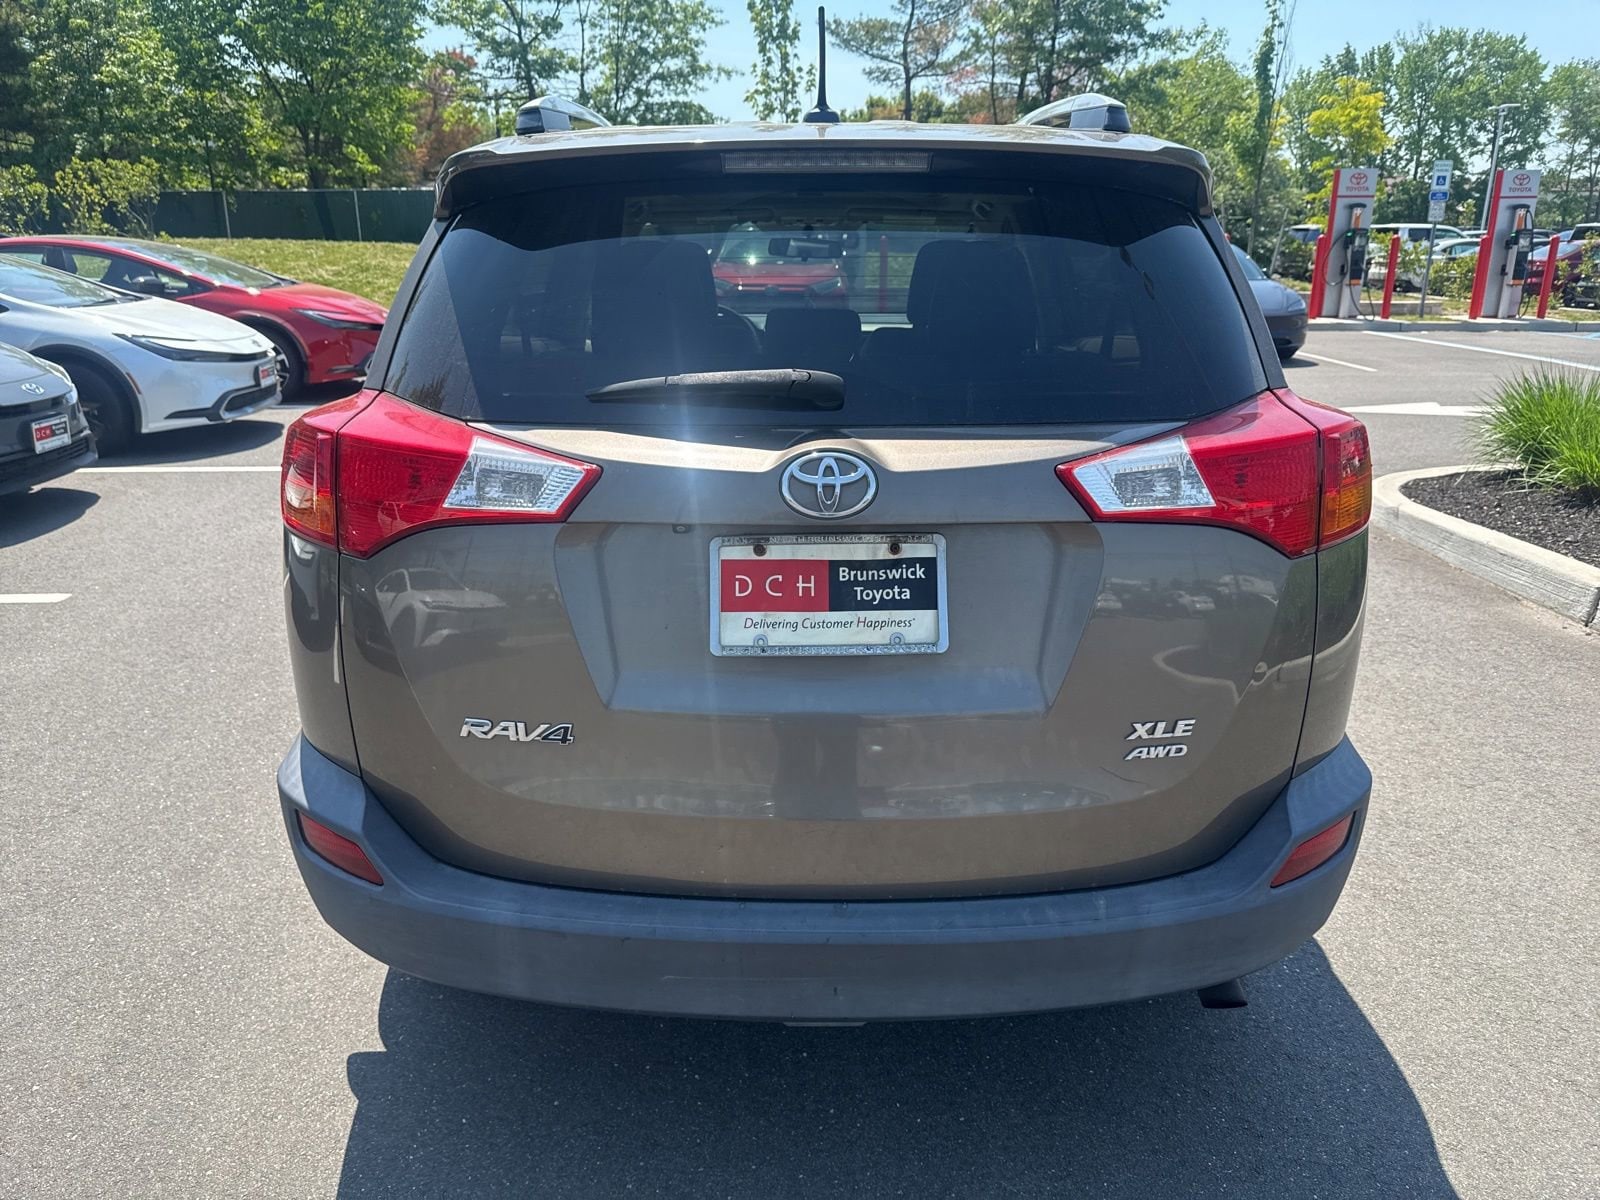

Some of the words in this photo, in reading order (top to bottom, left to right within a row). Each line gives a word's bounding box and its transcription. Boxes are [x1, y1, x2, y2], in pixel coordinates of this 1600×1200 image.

[1345, 185, 1370, 193] TOYOTA
[838, 564, 926, 582] Brunswick
[853, 586, 911, 604] Toyota
[743, 617, 799, 632] Delivering
[801, 618, 854, 630] Customer
[459, 717, 575, 746] RAV4
[1125, 719, 1196, 741] XLE
[1124, 744, 1188, 761] AWD
